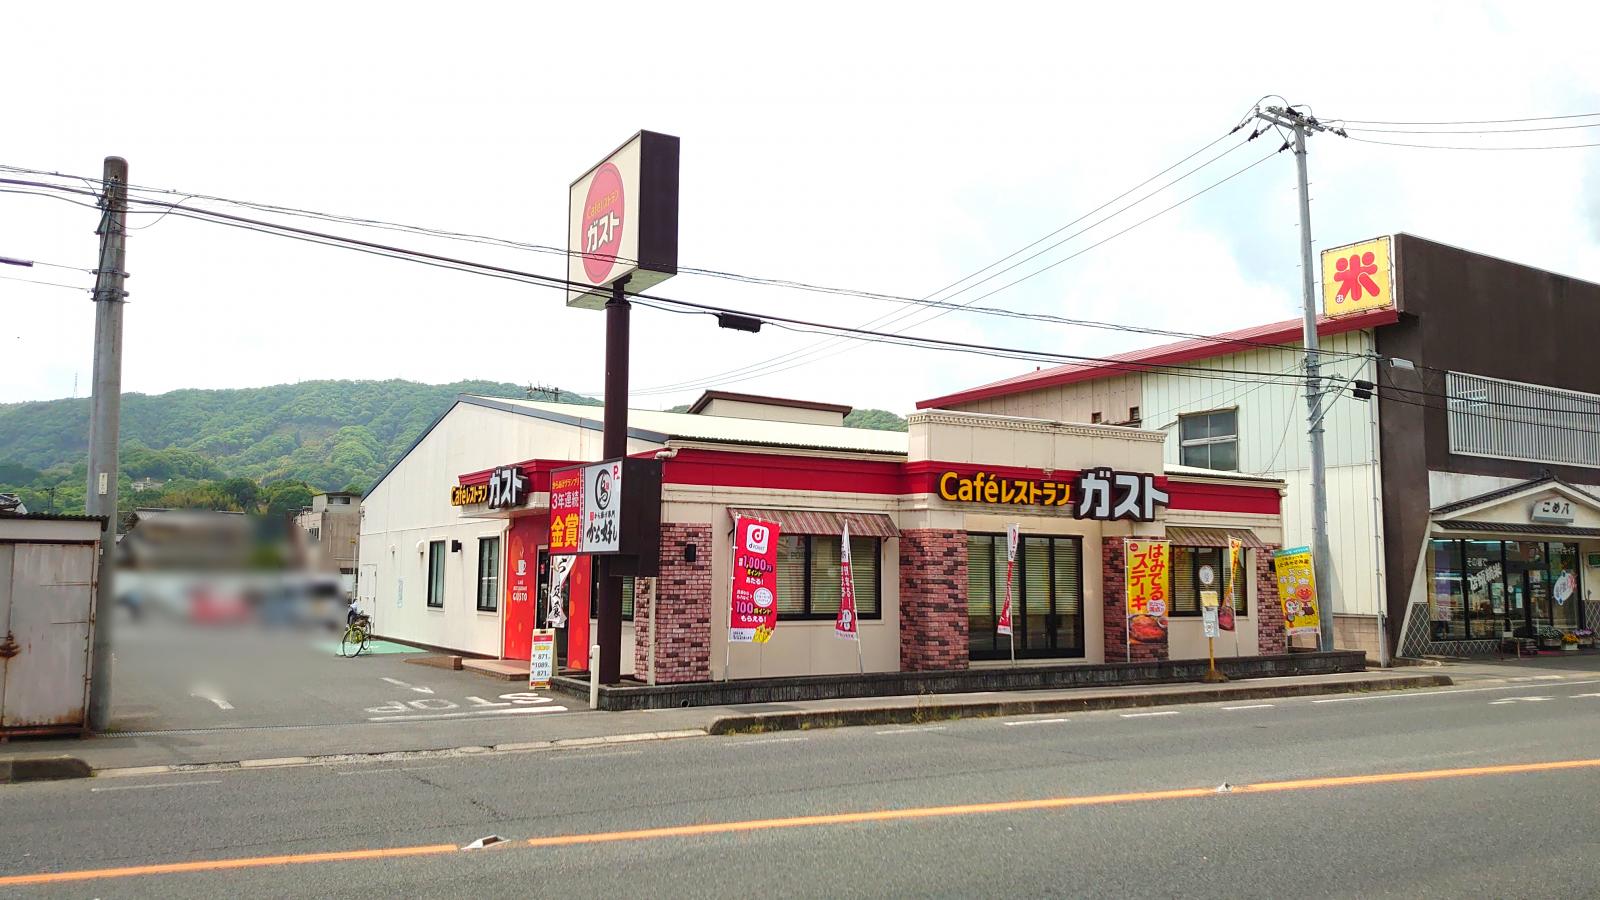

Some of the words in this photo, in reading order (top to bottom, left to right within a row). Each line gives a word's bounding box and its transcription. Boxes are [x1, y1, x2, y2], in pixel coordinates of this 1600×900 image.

[586, 211, 620, 254] ガスト
[1334, 252, 1380, 302] 米
[488, 467, 523, 508] ガスト
[552, 491, 579, 509] 3年連続
[1079, 471, 1169, 519] ガスト
[1542, 501, 1570, 515] こめ八
[551, 513, 579, 547] 金賞
[1131, 553, 1149, 610] ステーキ
[1148, 544, 1164, 600] はみでる
